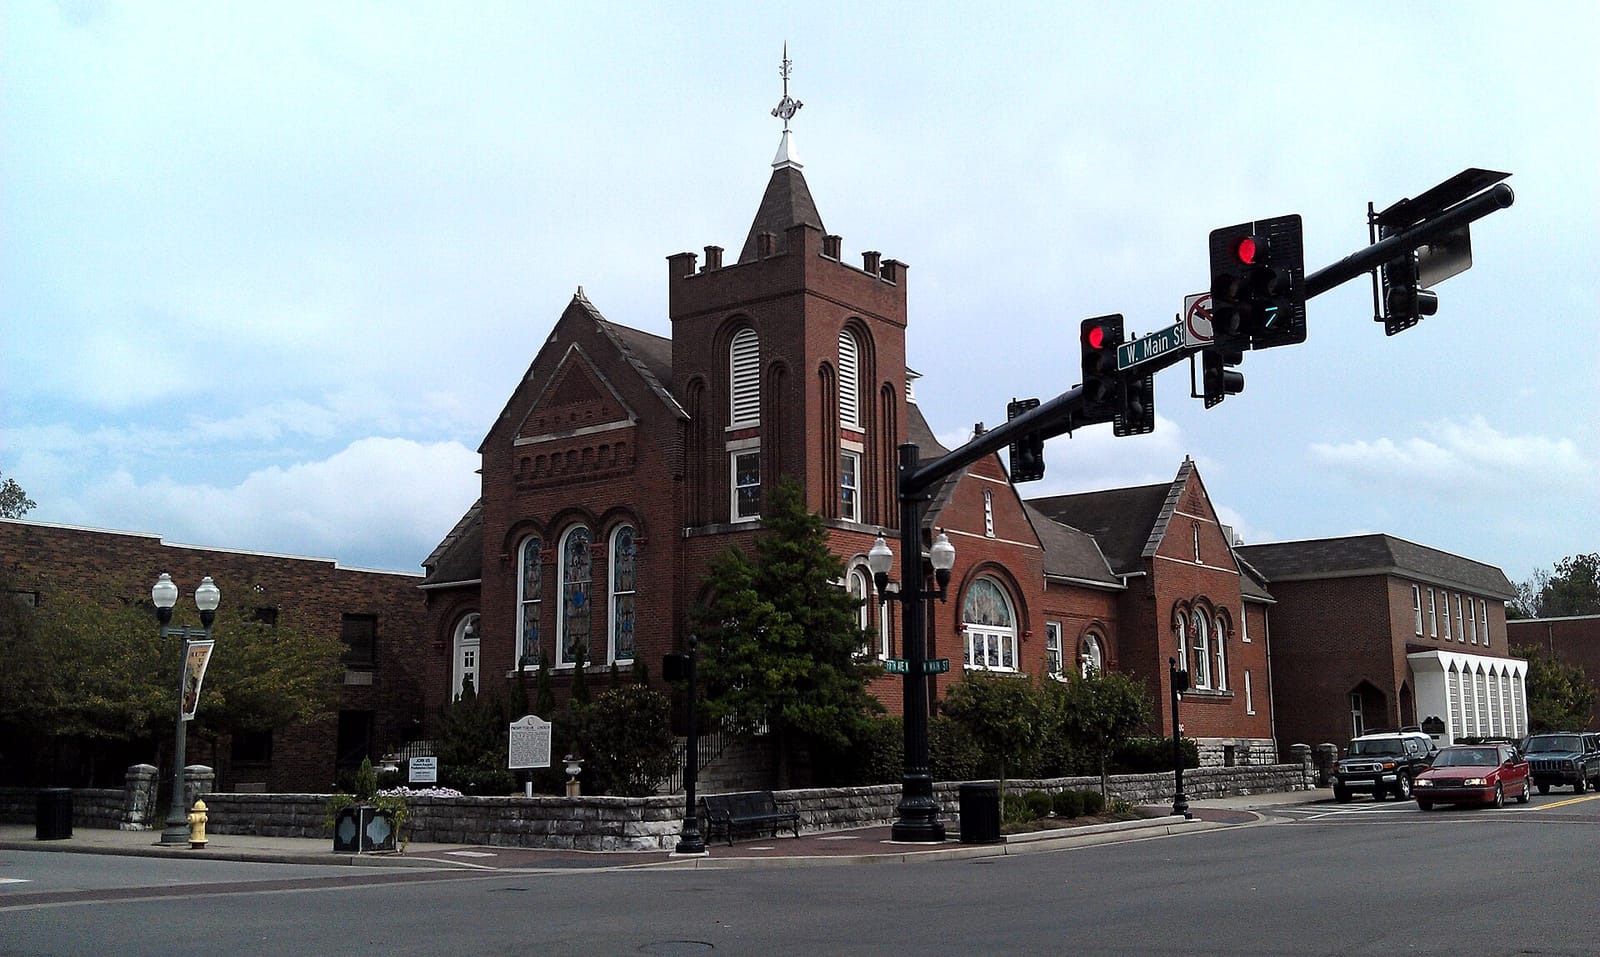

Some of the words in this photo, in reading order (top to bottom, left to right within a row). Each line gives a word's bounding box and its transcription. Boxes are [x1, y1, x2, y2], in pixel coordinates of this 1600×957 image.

[1126, 344, 1138, 363] W.
[1143, 334, 1169, 358] Main
[1173, 325, 1184, 346] St
